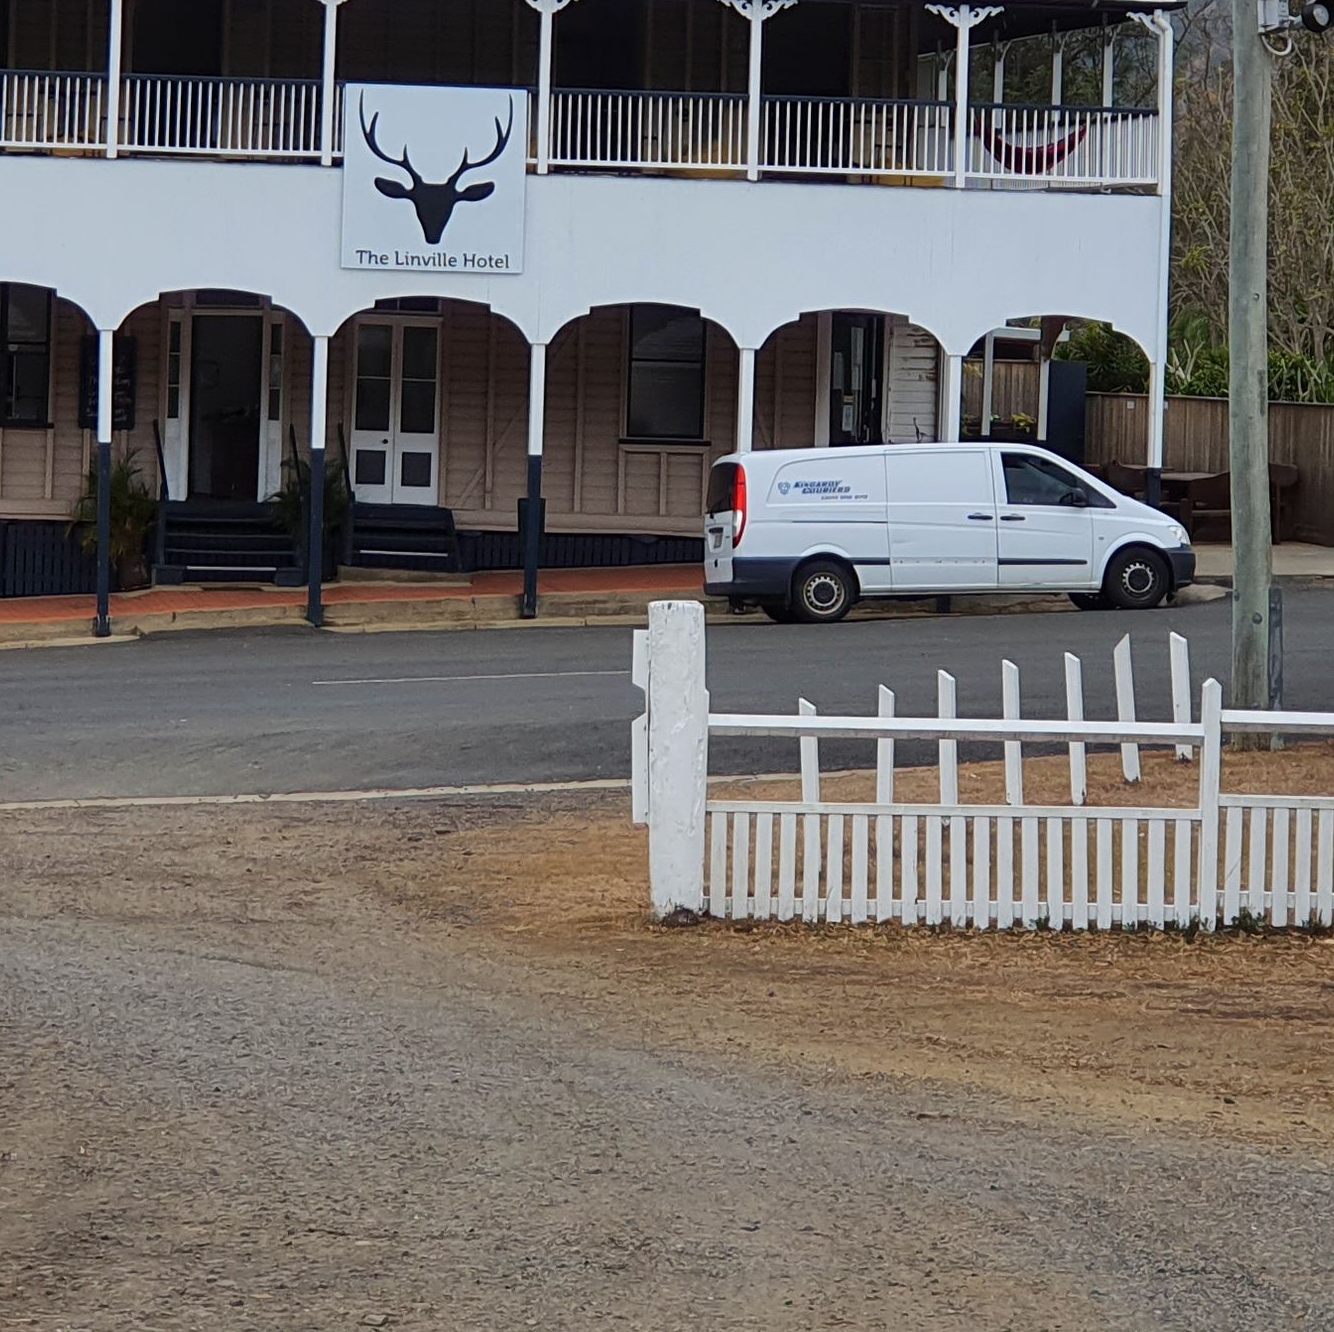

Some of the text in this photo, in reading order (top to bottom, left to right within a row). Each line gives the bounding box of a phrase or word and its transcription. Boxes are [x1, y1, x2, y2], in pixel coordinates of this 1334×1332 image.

[356, 250, 510, 269] The Linville Hotel
